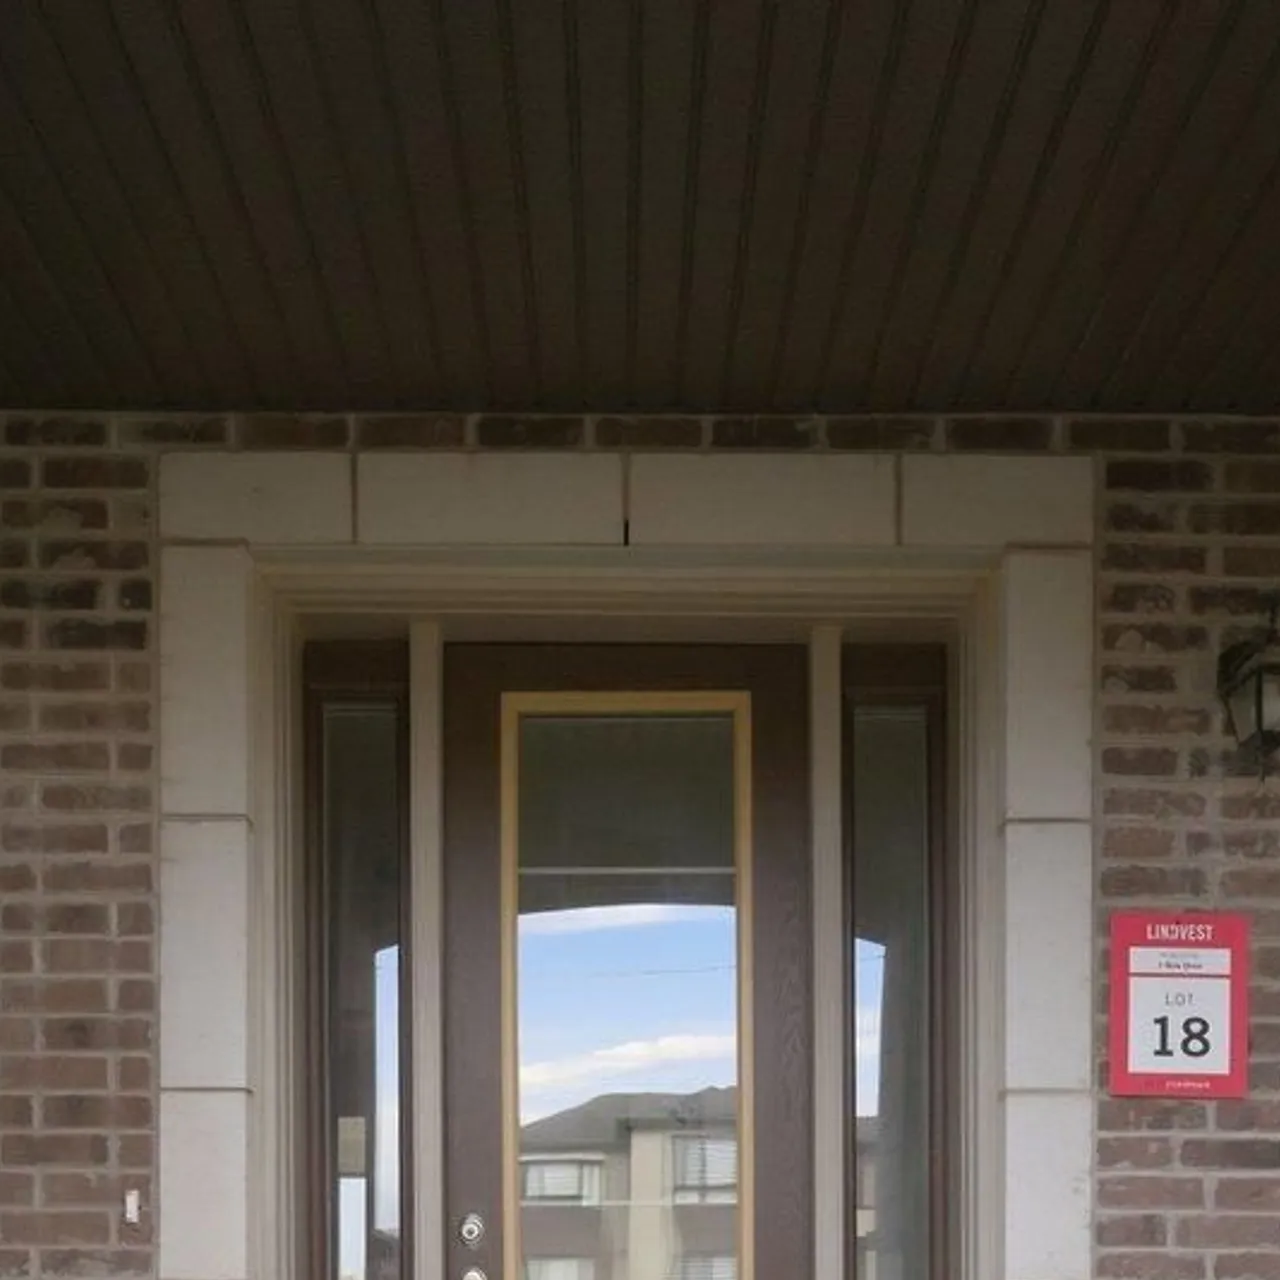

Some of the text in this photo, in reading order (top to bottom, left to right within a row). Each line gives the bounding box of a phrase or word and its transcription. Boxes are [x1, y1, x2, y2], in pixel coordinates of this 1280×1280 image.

[1146, 923, 1213, 941] LINDVEST
[1165, 992, 1194, 1006] LOT
[1153, 1015, 1211, 1057] 18
